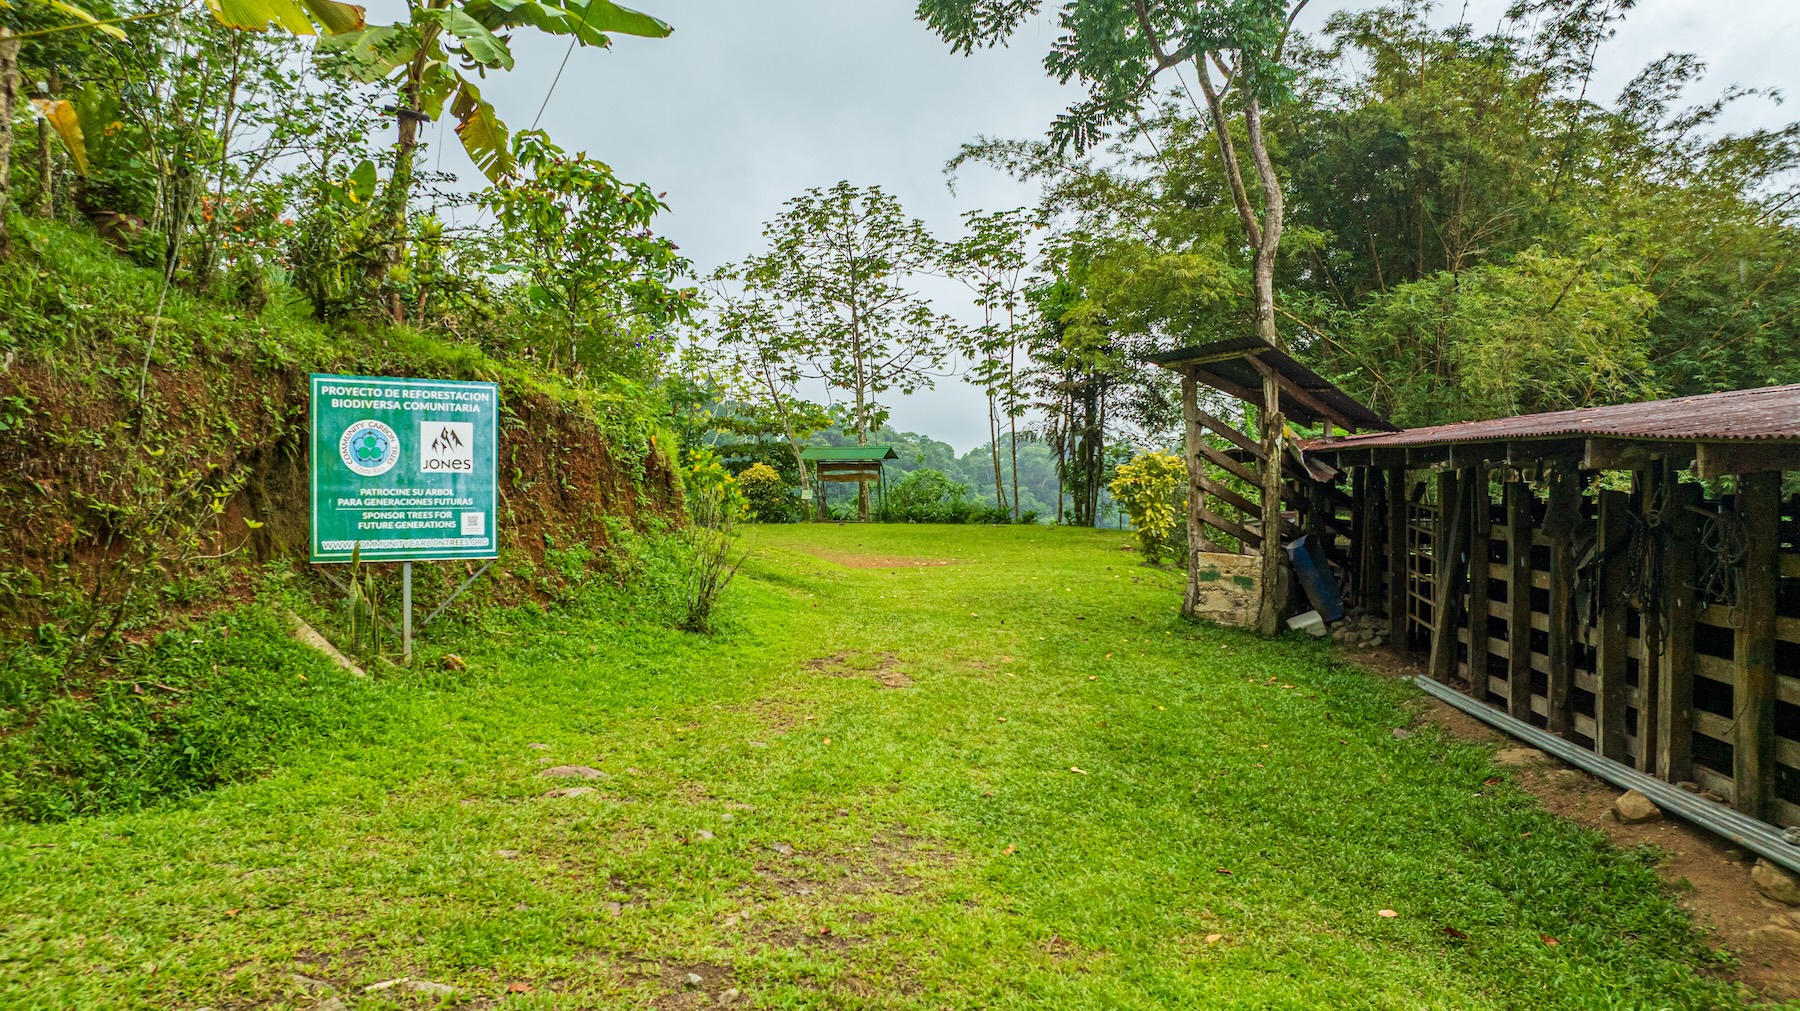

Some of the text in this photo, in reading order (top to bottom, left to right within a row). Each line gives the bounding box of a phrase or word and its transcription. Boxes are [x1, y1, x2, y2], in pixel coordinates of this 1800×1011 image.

[321, 386, 490, 401] PROYECTO DE REFORESTACION
[331, 399, 480, 413] BIODIVERSA COMUNITARIA
[341, 421, 398, 465] COMMUNITY CARBON TREES
[360, 488, 454, 496] PATROCINE SU ARBOL
[364, 498, 433, 506] GENERACIONES
[434, 497, 473, 506] FUTURAS
[362, 511, 452, 520] SPONSOR TREES FOR
[358, 520, 457, 530] FUTURE GENERATIONS
